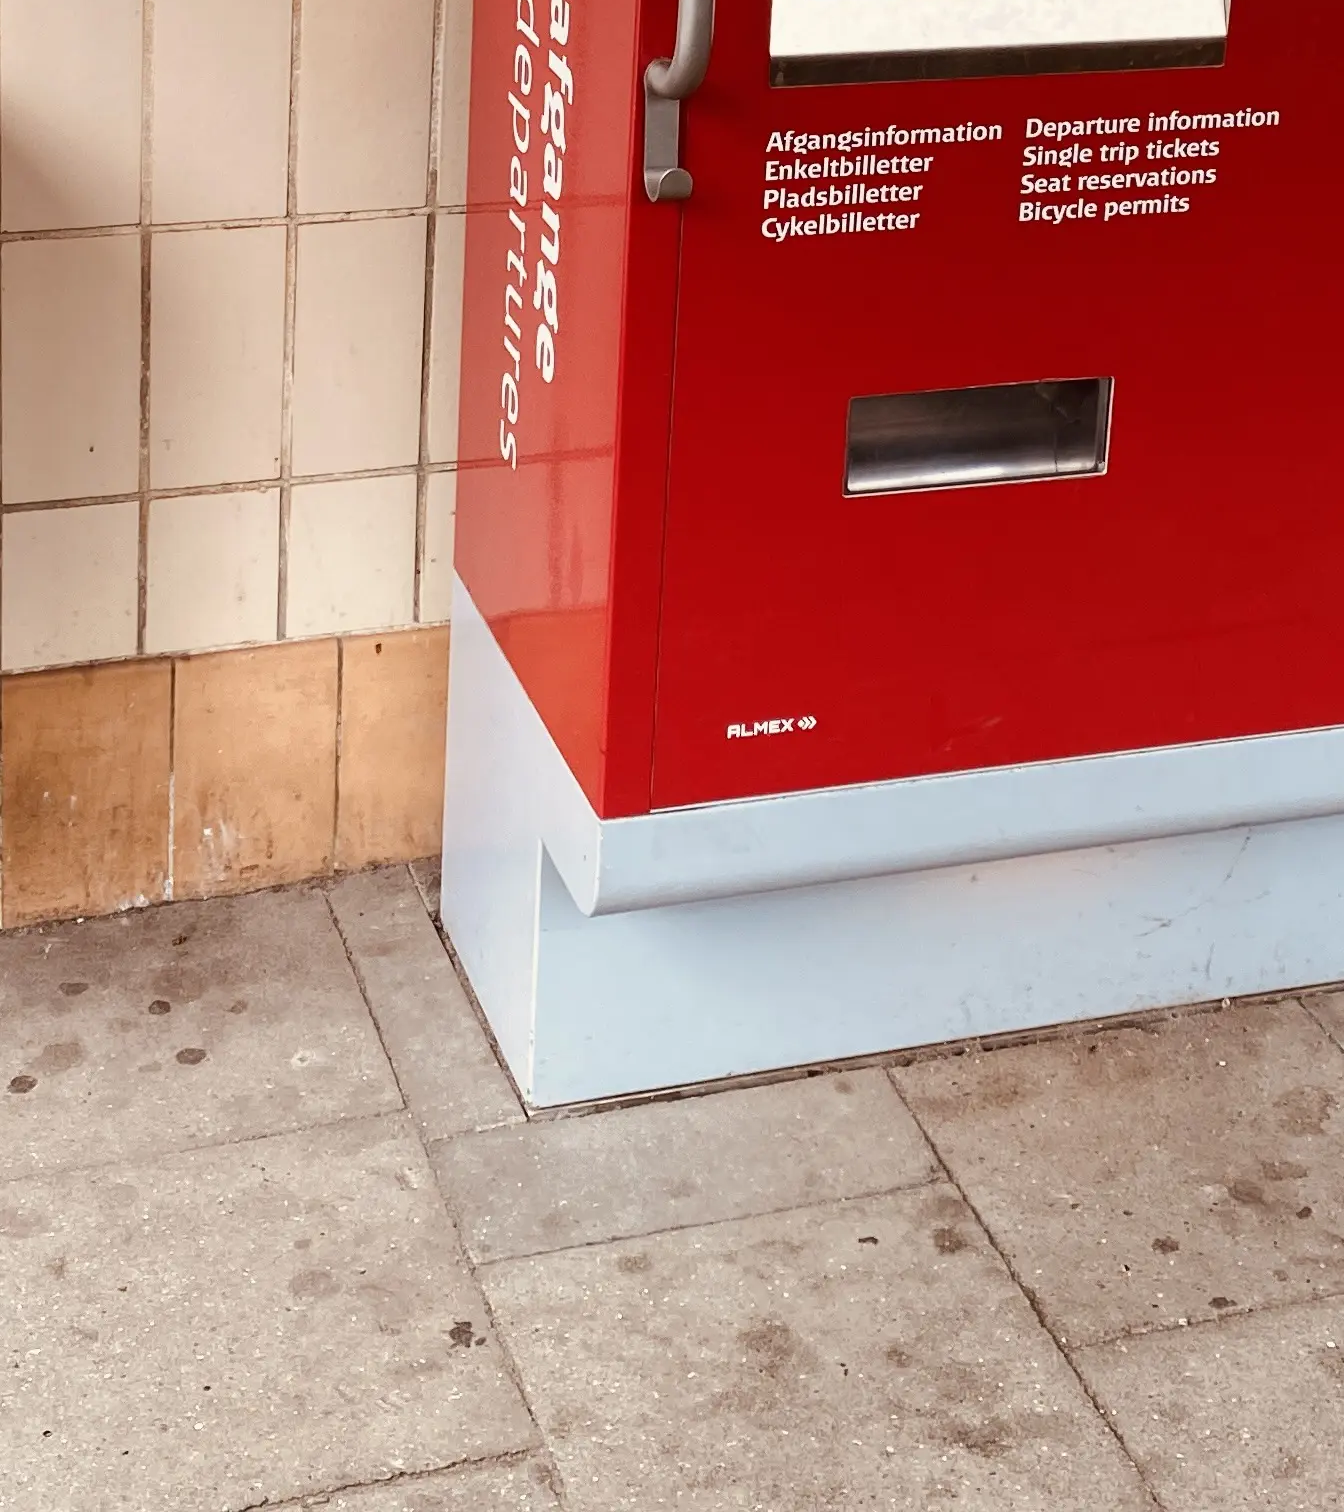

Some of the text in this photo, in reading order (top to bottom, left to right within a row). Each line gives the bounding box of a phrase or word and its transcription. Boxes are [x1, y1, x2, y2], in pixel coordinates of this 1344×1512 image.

[766, 122, 1003, 154] Afgangsinformation
[1025, 108, 1280, 143] Departure information
[764, 154, 934, 181] Enkeltbilletter
[1023, 137, 1220, 168] Single trip tickets
[763, 182, 923, 210] Pladsbilletter
[1020, 166, 1216, 195] Seat reservations
[1018, 194, 1190, 225] Bicycle permits
[761, 210, 920, 242] Cykelbilletter
[727, 718, 795, 739] ALMEX
